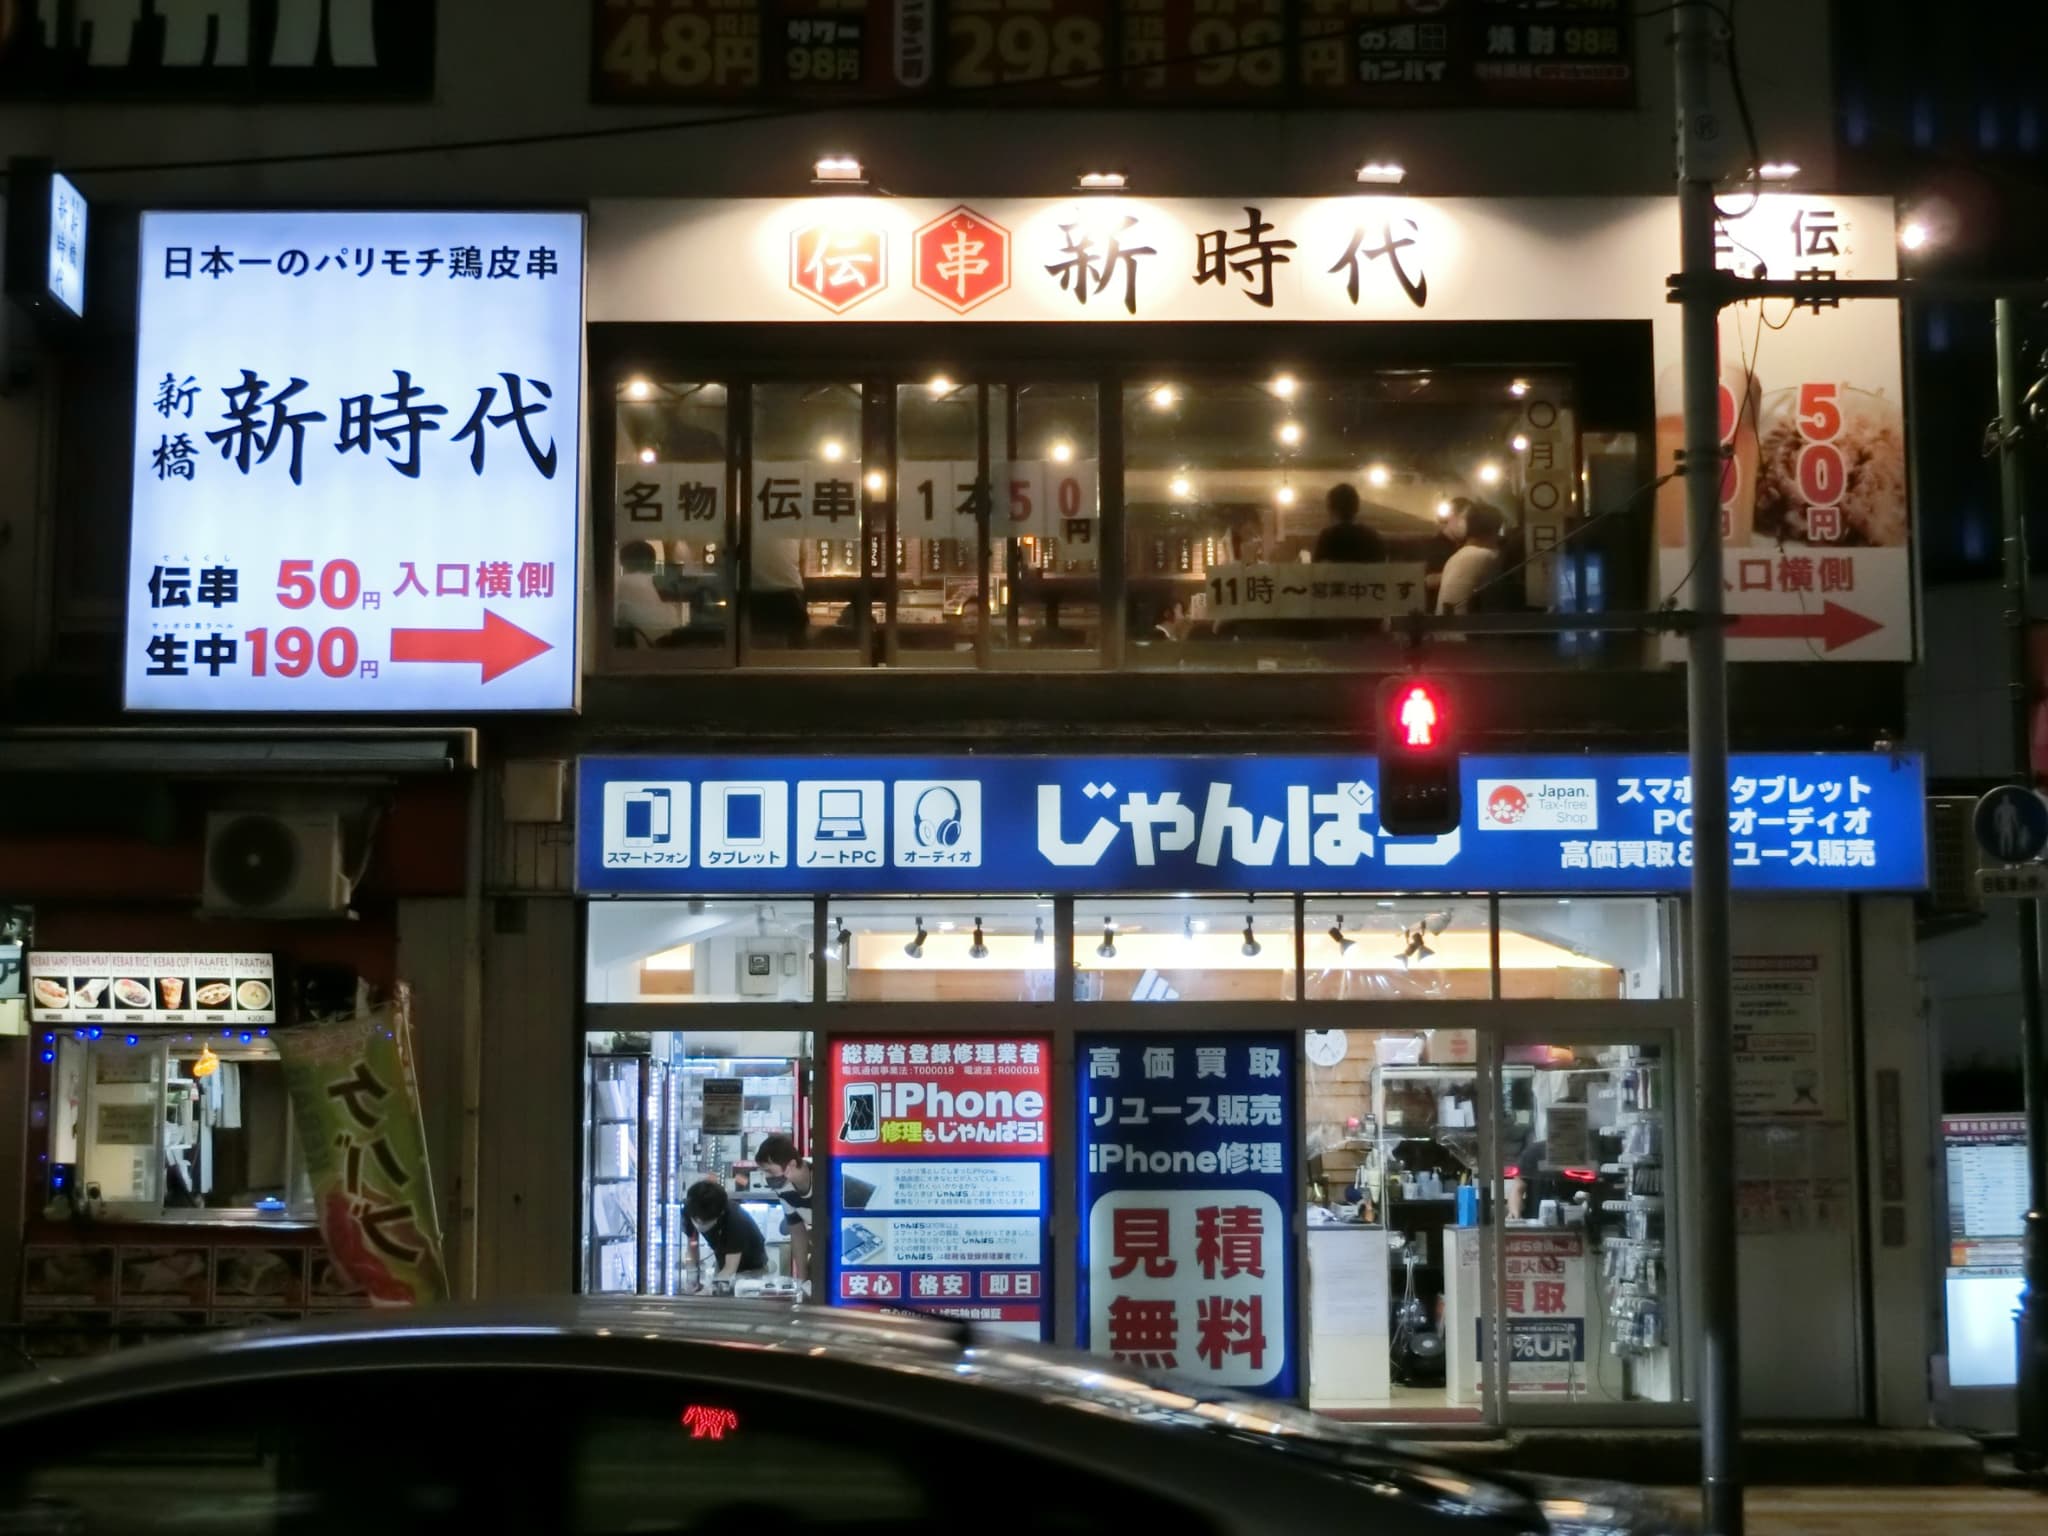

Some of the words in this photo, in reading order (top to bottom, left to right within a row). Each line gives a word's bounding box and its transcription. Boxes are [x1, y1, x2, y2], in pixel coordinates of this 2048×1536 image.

[163, 245, 559, 280] 日本一のパリモチ鶏皮串
[936, 229, 991, 300] 串
[1043, 206, 1428, 315] 新時代
[152, 371, 202, 482] 新橋
[205, 369, 559, 487] 新時代
[1799, 382, 1846, 540] 50円
[622, 480, 718, 523] 名物
[756, 477, 857, 524] 伝串
[148, 564, 239, 609] 伝串
[276, 558, 381, 611] 50円
[392, 561, 555, 599] 入口横側
[1721, 556, 1855, 592] 口横側
[145, 632, 238, 677] 生中
[244, 626, 380, 680] 190円
[1538, 799, 1588, 811] Tax-free
[1557, 812, 1588, 825] Shop
[607, 851, 689, 864] スマートフォン
[708, 850, 780, 864] タブレット
[806, 850, 877, 864] ノートPC
[904, 850, 973, 864] オーディオ
[195, 957, 229, 968] FALAFEL
[235, 957, 272, 969] PARATHA
[842, 1043, 1041, 1065] 総務省登録修理業者
[1089, 1047, 1282, 1079] 高価買取
[880, 1081, 1044, 1119] iPhone
[1089, 1094, 1282, 1127] リユース販売
[1089, 1142, 1283, 1175] iPhone修理
[1109, 1205, 1265, 1280] 見積
[849, 1275, 893, 1295] 安心
[919, 1275, 963, 1295] 格安
[989, 1274, 1032, 1295] 即日
[1108, 1294, 1267, 1370] 無料
